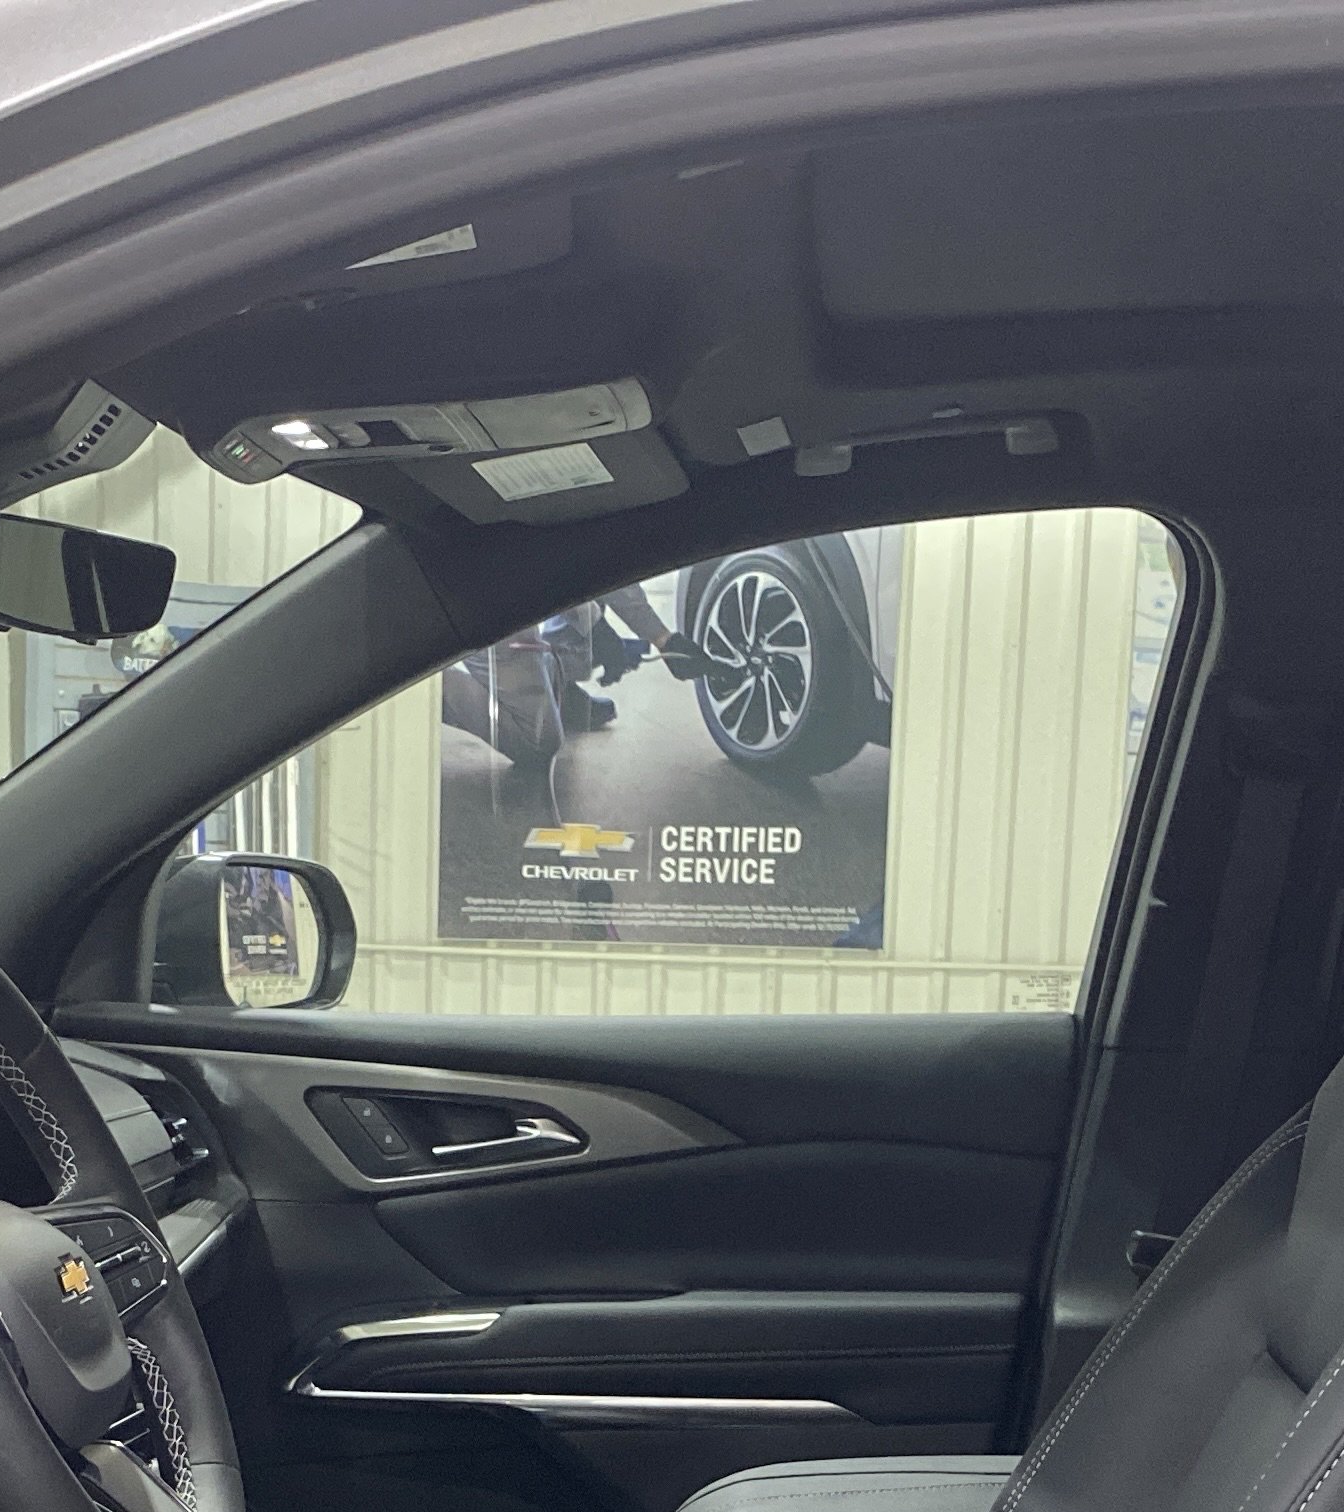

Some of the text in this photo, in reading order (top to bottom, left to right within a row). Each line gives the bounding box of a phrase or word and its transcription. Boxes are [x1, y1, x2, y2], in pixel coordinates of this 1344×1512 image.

[660, 825, 802, 854] CERTIFIED
[521, 864, 639, 883] CHEVROLET
[659, 857, 776, 884] SERVICE
